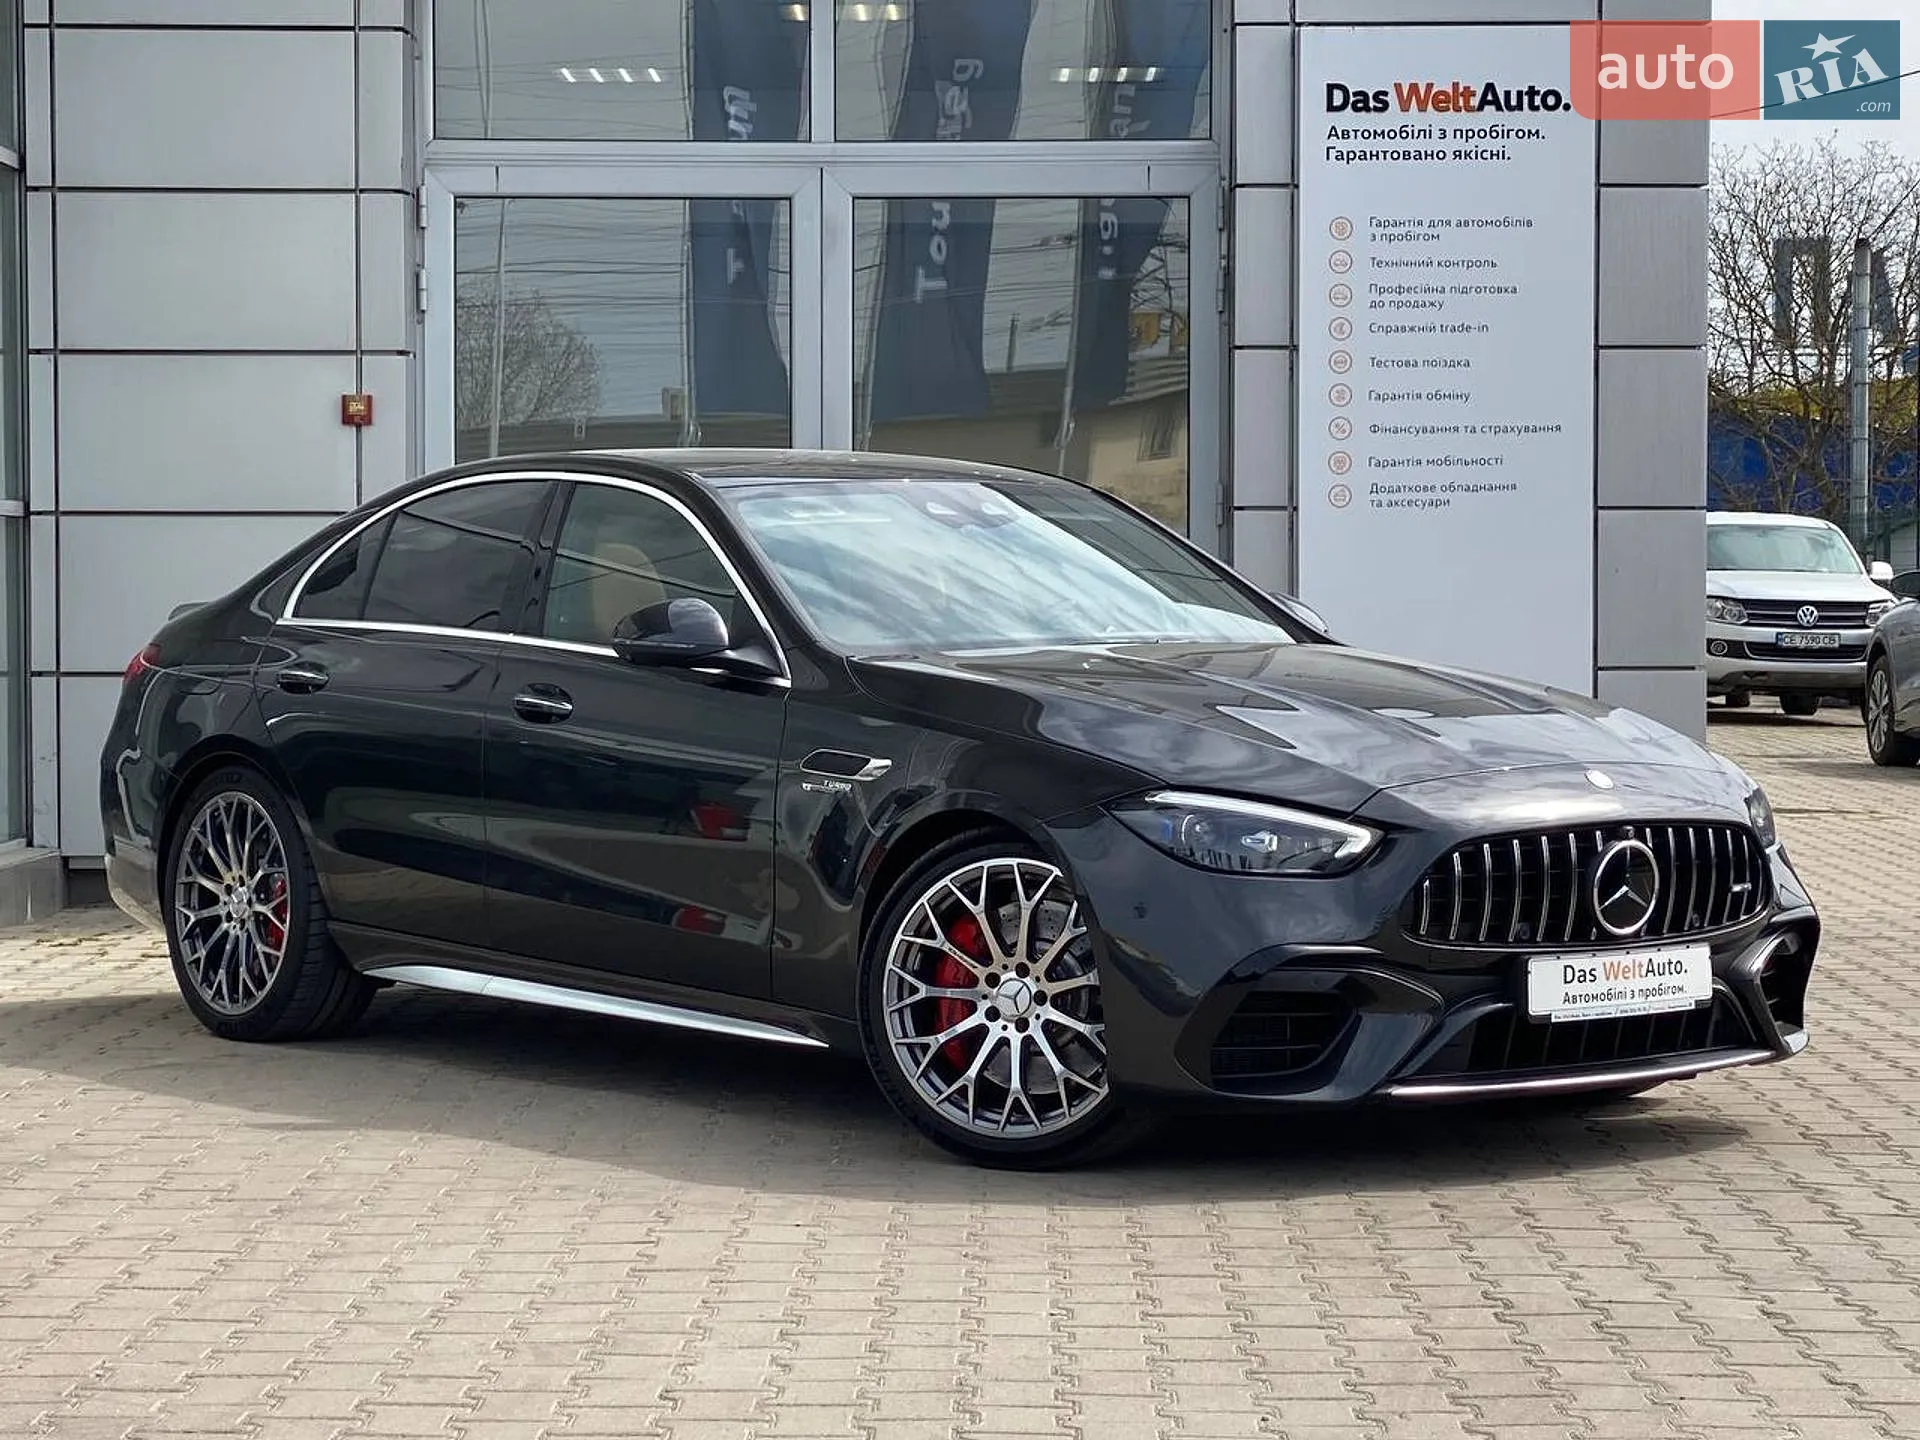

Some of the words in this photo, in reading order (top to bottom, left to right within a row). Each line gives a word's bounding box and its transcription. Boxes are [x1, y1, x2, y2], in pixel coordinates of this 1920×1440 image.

[1325, 82, 1390, 113] Das
[1394, 82, 1572, 113] WeltAuto.
[1327, 122, 1433, 143] Автомобілі
[1437, 128, 1448, 141] з
[1452, 124, 1546, 143] пробігом.
[1325, 145, 1448, 164] Гарантовано
[1451, 145, 1512, 162] якісні.
[1369, 216, 1424, 230] Гарантія
[1427, 218, 1452, 229] для
[1455, 216, 1534, 229] автомобілів
[1369, 232, 1377, 242] з
[1379, 231, 1441, 244] пробігом
[1369, 256, 1434, 268] Технічний
[1437, 257, 1498, 270] контроль
[1369, 283, 1446, 297] Професійна
[1449, 285, 1518, 297] підготовка
[1369, 299, 1386, 310] до
[1388, 300, 1446, 311] продажу
[1368, 321, 1437, 335] Справжній
[1440, 321, 1490, 333] trade-in
[1369, 357, 1419, 369] Тестова
[1422, 356, 1471, 370] поїздка
[1368, 389, 1423, 403] Гарантія
[1426, 387, 1471, 404] обміну
[1368, 422, 1460, 437] Фінансування
[1463, 424, 1478, 435] та
[1480, 423, 1562, 436] страхування
[1368, 455, 1423, 469] Гарантія
[1425, 454, 1504, 468] мобільності
[1369, 482, 1437, 496] Додаткове
[1440, 481, 1517, 495] обладнання
[1369, 499, 1384, 509] та
[1386, 499, 1451, 511] аксесуари
[1563, 963, 1598, 985] Das
[1602, 957, 1688, 982] WeltAuto.
[1562, 987, 1627, 1005] Автомобілі
[1630, 989, 1635, 999] з
[1638, 982, 1687, 1002] пробігом.
